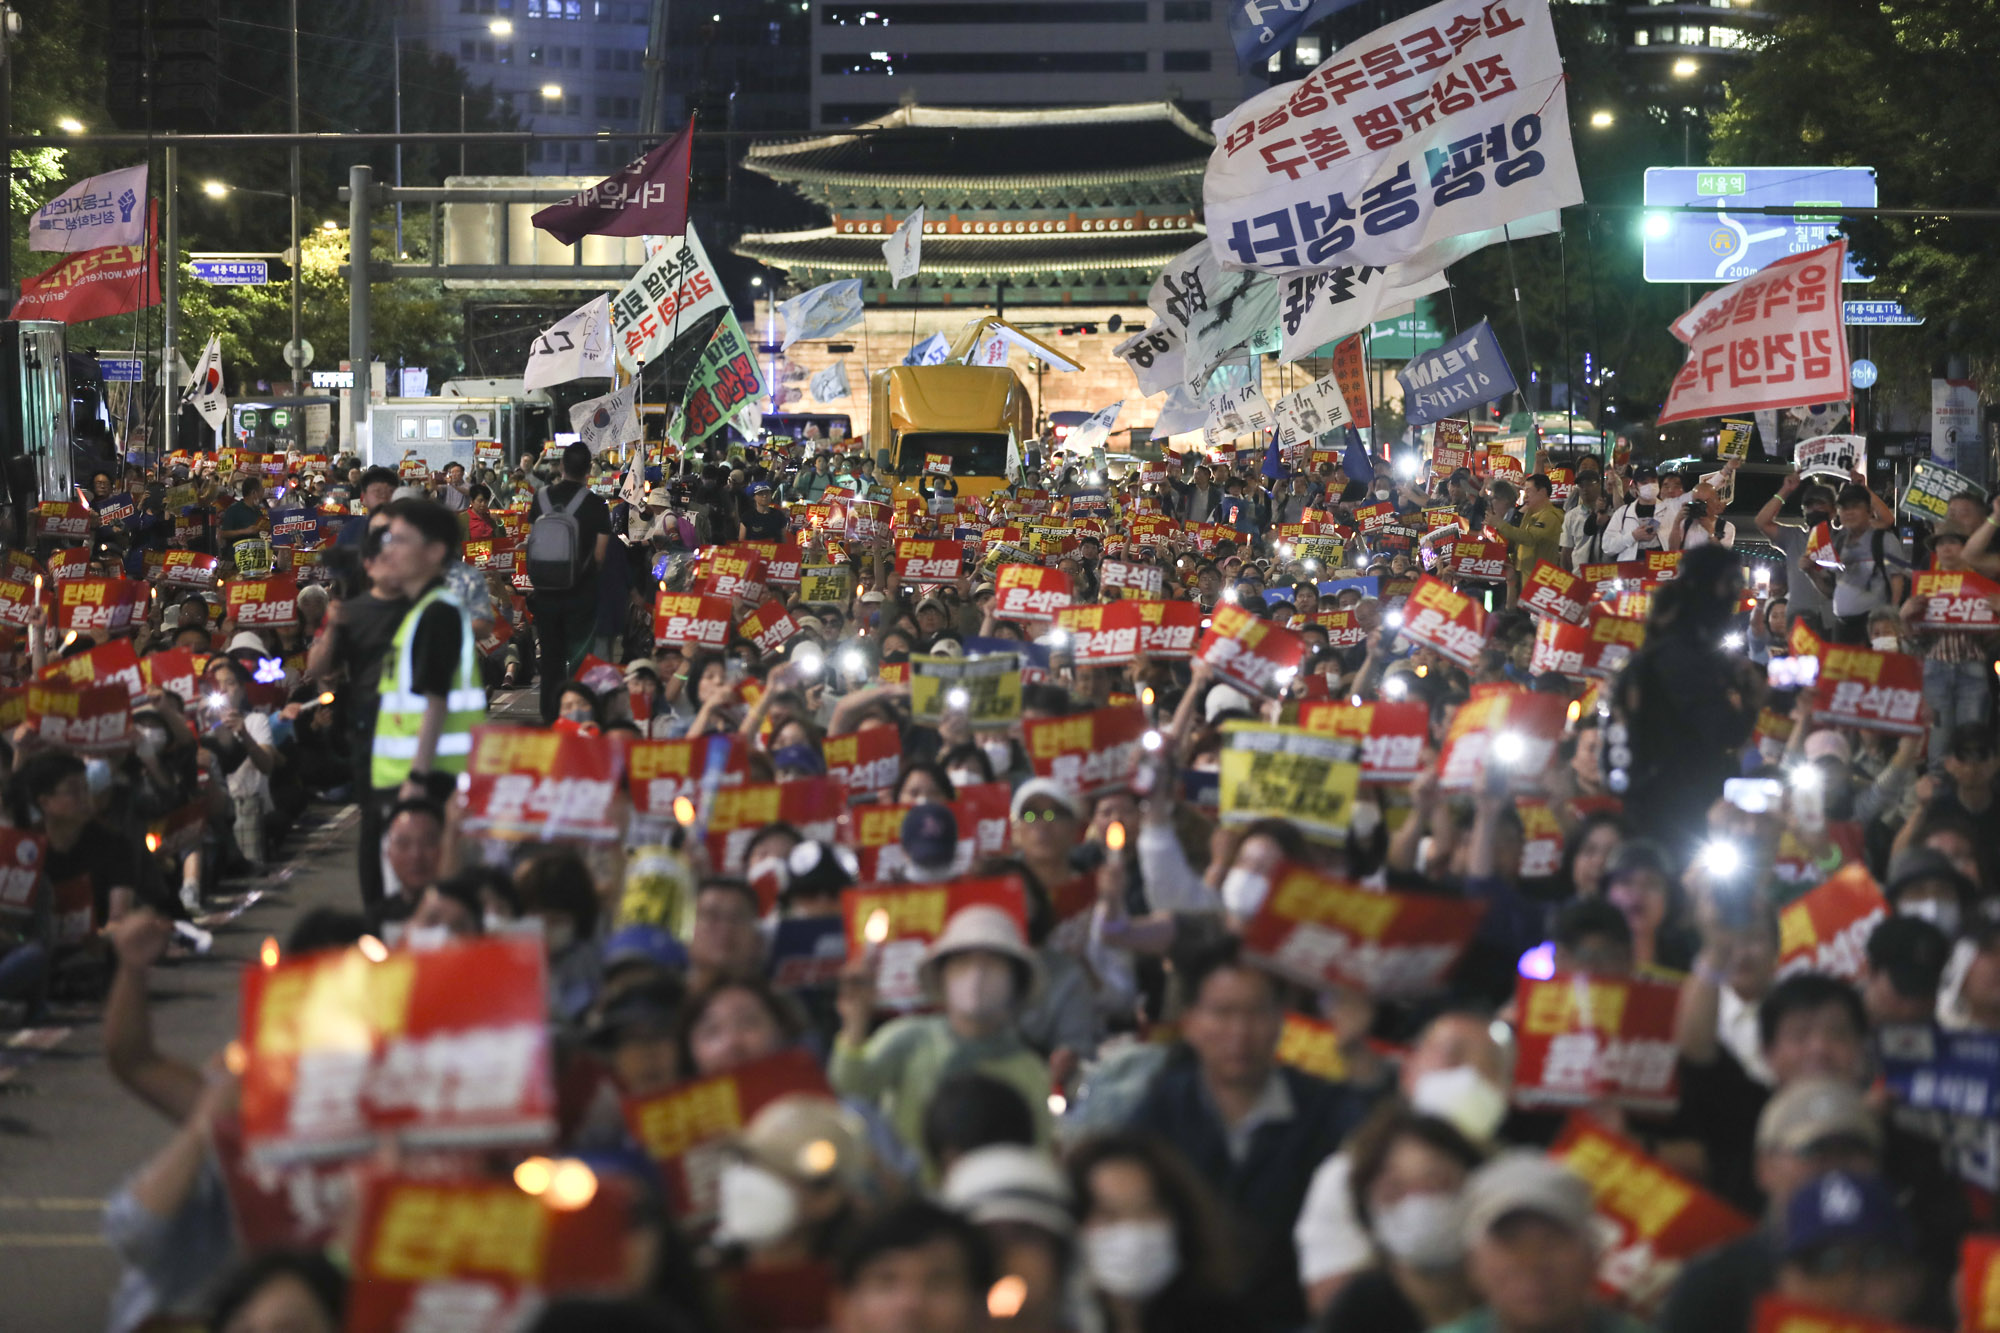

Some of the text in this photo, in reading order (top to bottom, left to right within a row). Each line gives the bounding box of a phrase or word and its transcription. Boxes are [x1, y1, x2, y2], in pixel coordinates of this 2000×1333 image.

[1701, 176, 1743, 192] 서울역
[210, 264, 265, 275] 세종대로12길
[1846, 304, 1902, 315] 세종대로11길
[926, 454, 942, 462] 탄핵
[928, 462, 951, 472] 윤석열
[1490, 456, 1511, 469] 탄핵
[41, 503, 69, 517] 탄핵
[808, 506, 831, 516] 탄핵
[1907, 490, 1949, 517] 윤석열
[1356, 506, 1377, 520] 탄핵
[45, 517, 88, 533] 윤석열
[1133, 525, 1154, 535] 탄핵
[1216, 526, 1237, 539] 탄핵
[1281, 525, 1304, 536] 탄핵
[982, 529, 1005, 540] 탄핵
[166, 551, 195, 565] 탄핵
[899, 541, 935, 559] 탄핵
[1456, 543, 1486, 558] 탄핵
[474, 552, 513, 569] 윤석열
[712, 558, 748, 577] 탄핵
[905, 559, 960, 577] 윤석열
[1459, 557, 1505, 575] 윤석열
[1000, 566, 1045, 588] 탄핵
[1103, 563, 1162, 591] 윤석열
[1534, 563, 1575, 594] 탄핵
[1916, 574, 1964, 596] 탄핵
[63, 584, 106, 606] 탄핵
[229, 583, 267, 605] 탄핵
[1004, 587, 1072, 613] 윤석열
[1414, 581, 1470, 620] 탄핵
[237, 600, 295, 623] 윤석열
[659, 596, 702, 618] 탄핵
[71, 605, 133, 629] 윤석열
[1058, 608, 1103, 632] 탄핵
[1317, 612, 1348, 629] 탄핵
[666, 617, 727, 643] 윤석열
[1407, 609, 1486, 660] 윤석열
